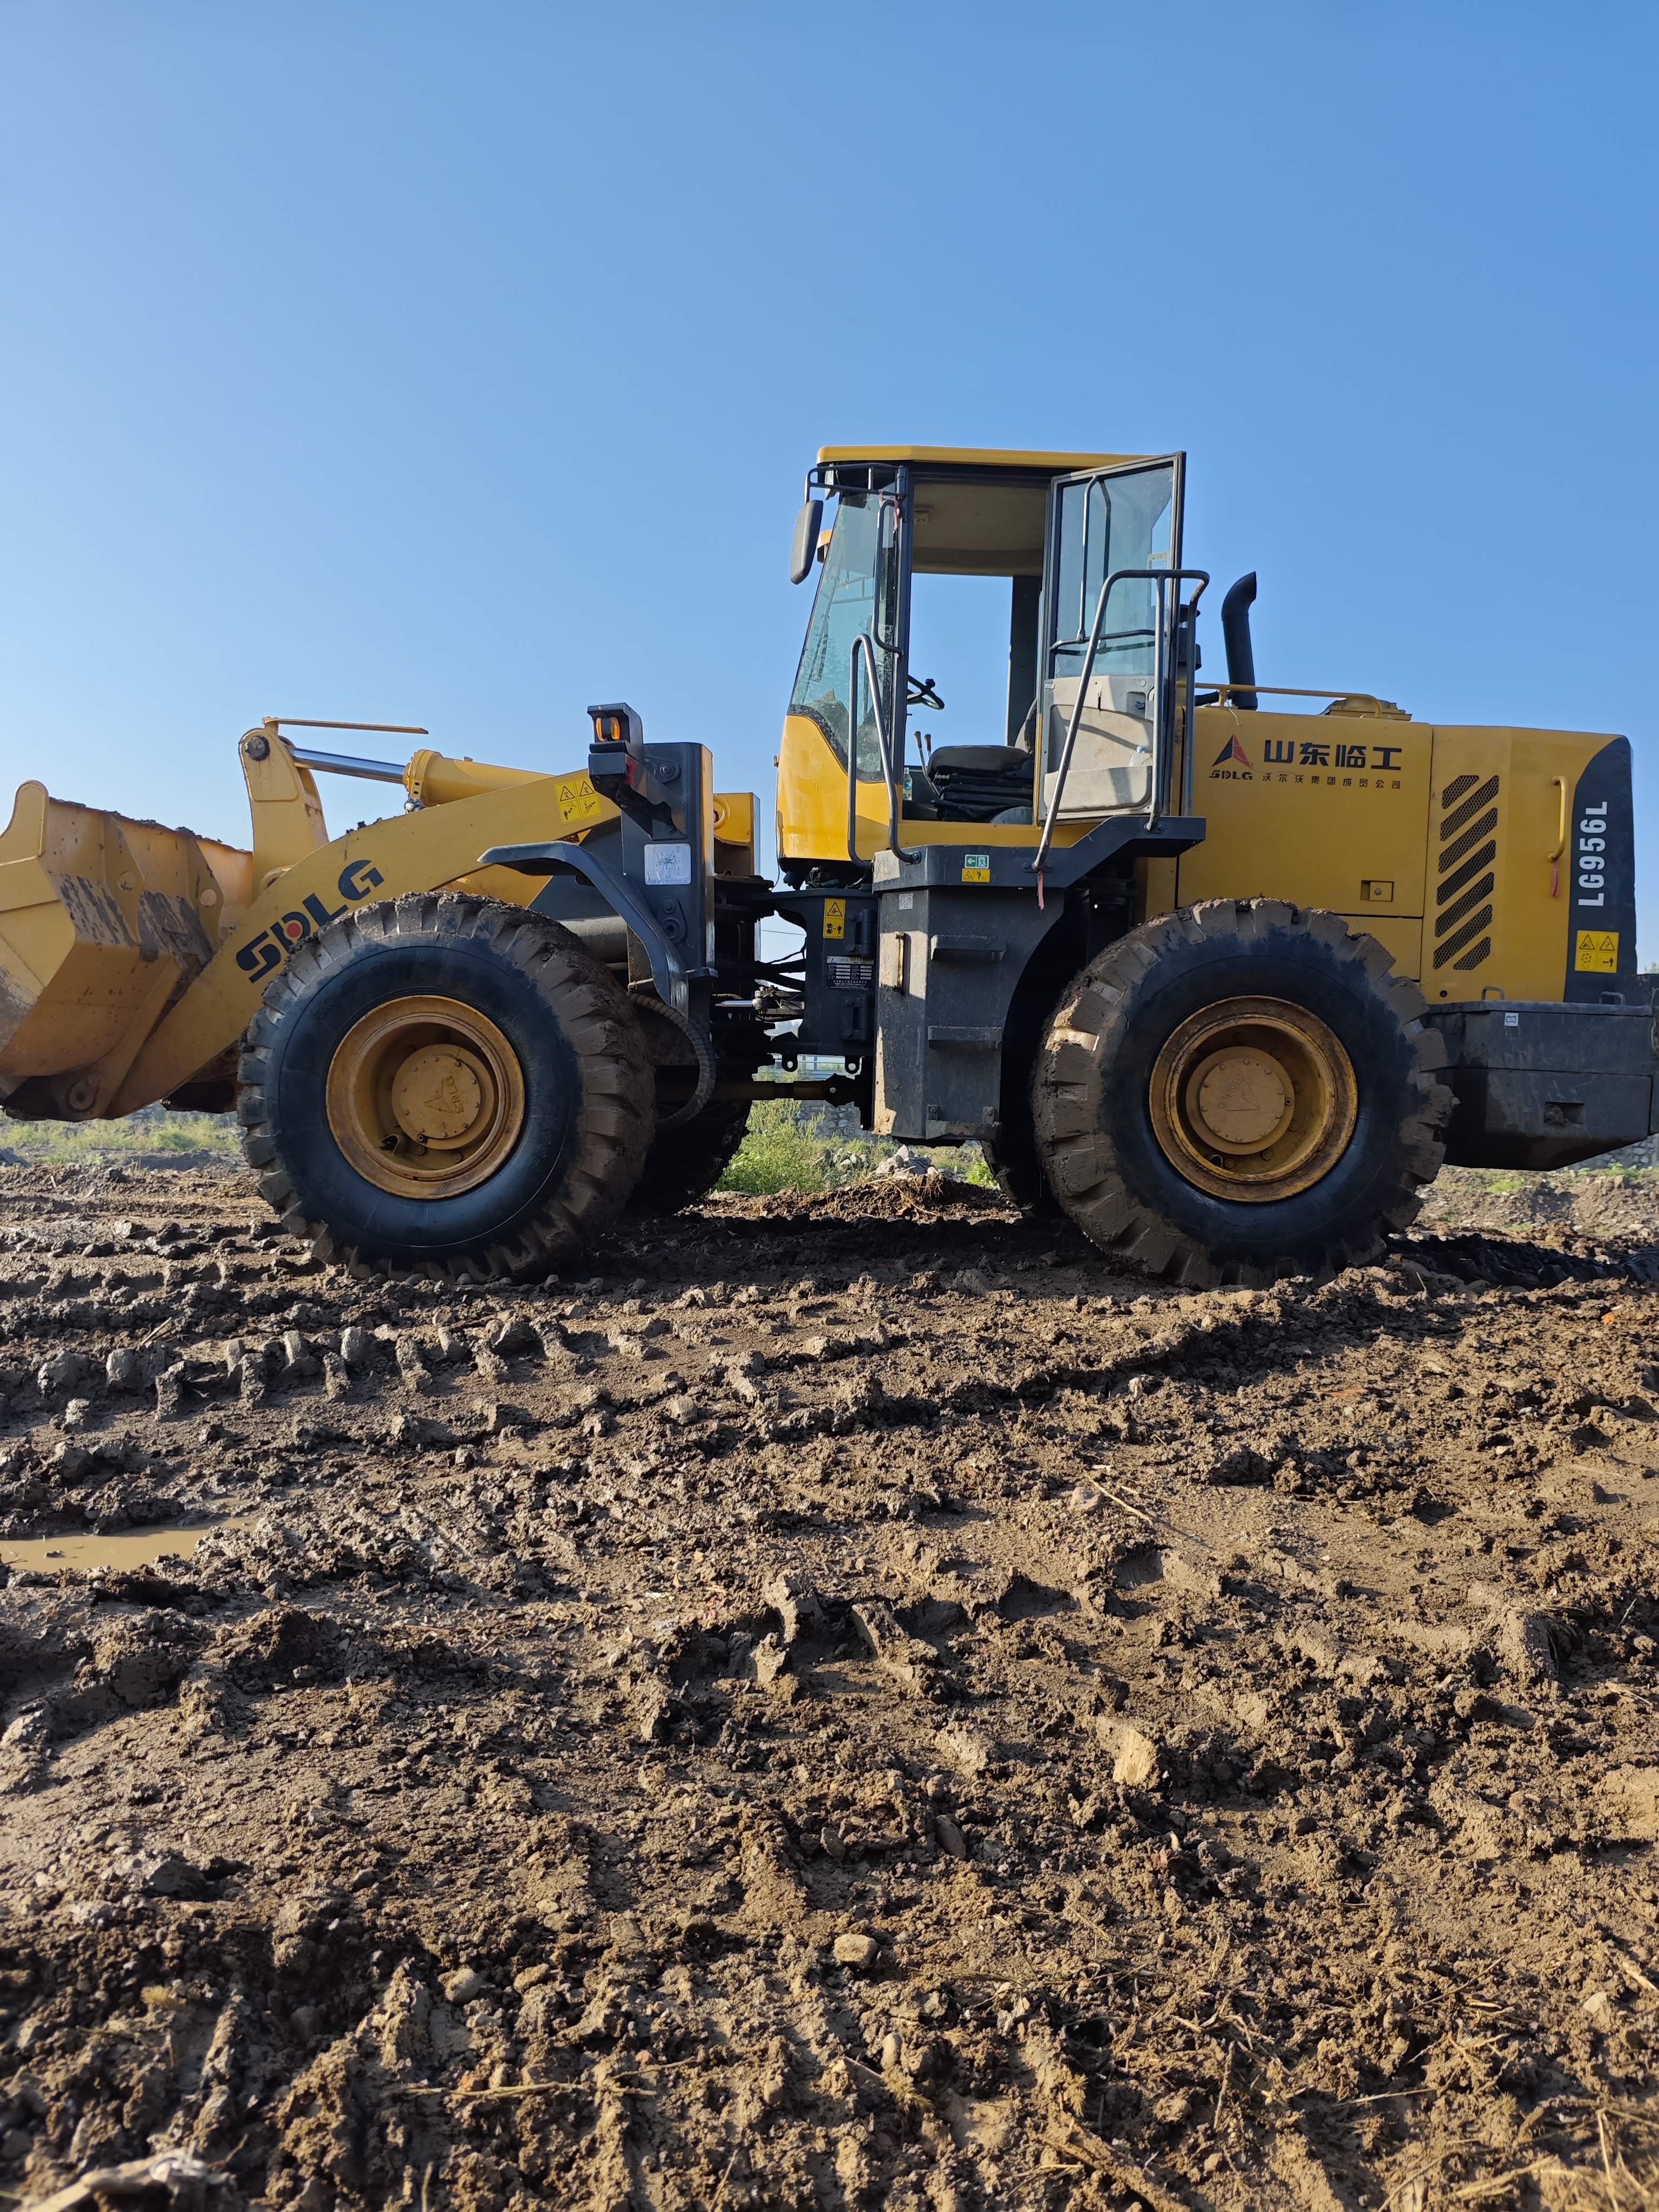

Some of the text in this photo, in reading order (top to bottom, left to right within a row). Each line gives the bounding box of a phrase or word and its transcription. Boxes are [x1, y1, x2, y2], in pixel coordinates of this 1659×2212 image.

[1264, 739, 1402, 771] 山东临工
[1209, 770, 1253, 780] SDLG
[1262, 773, 1400, 790] 沃尔沃集团成员公司
[1578, 801, 1608, 906] LG956L
[236, 860, 385, 983] SDLG
